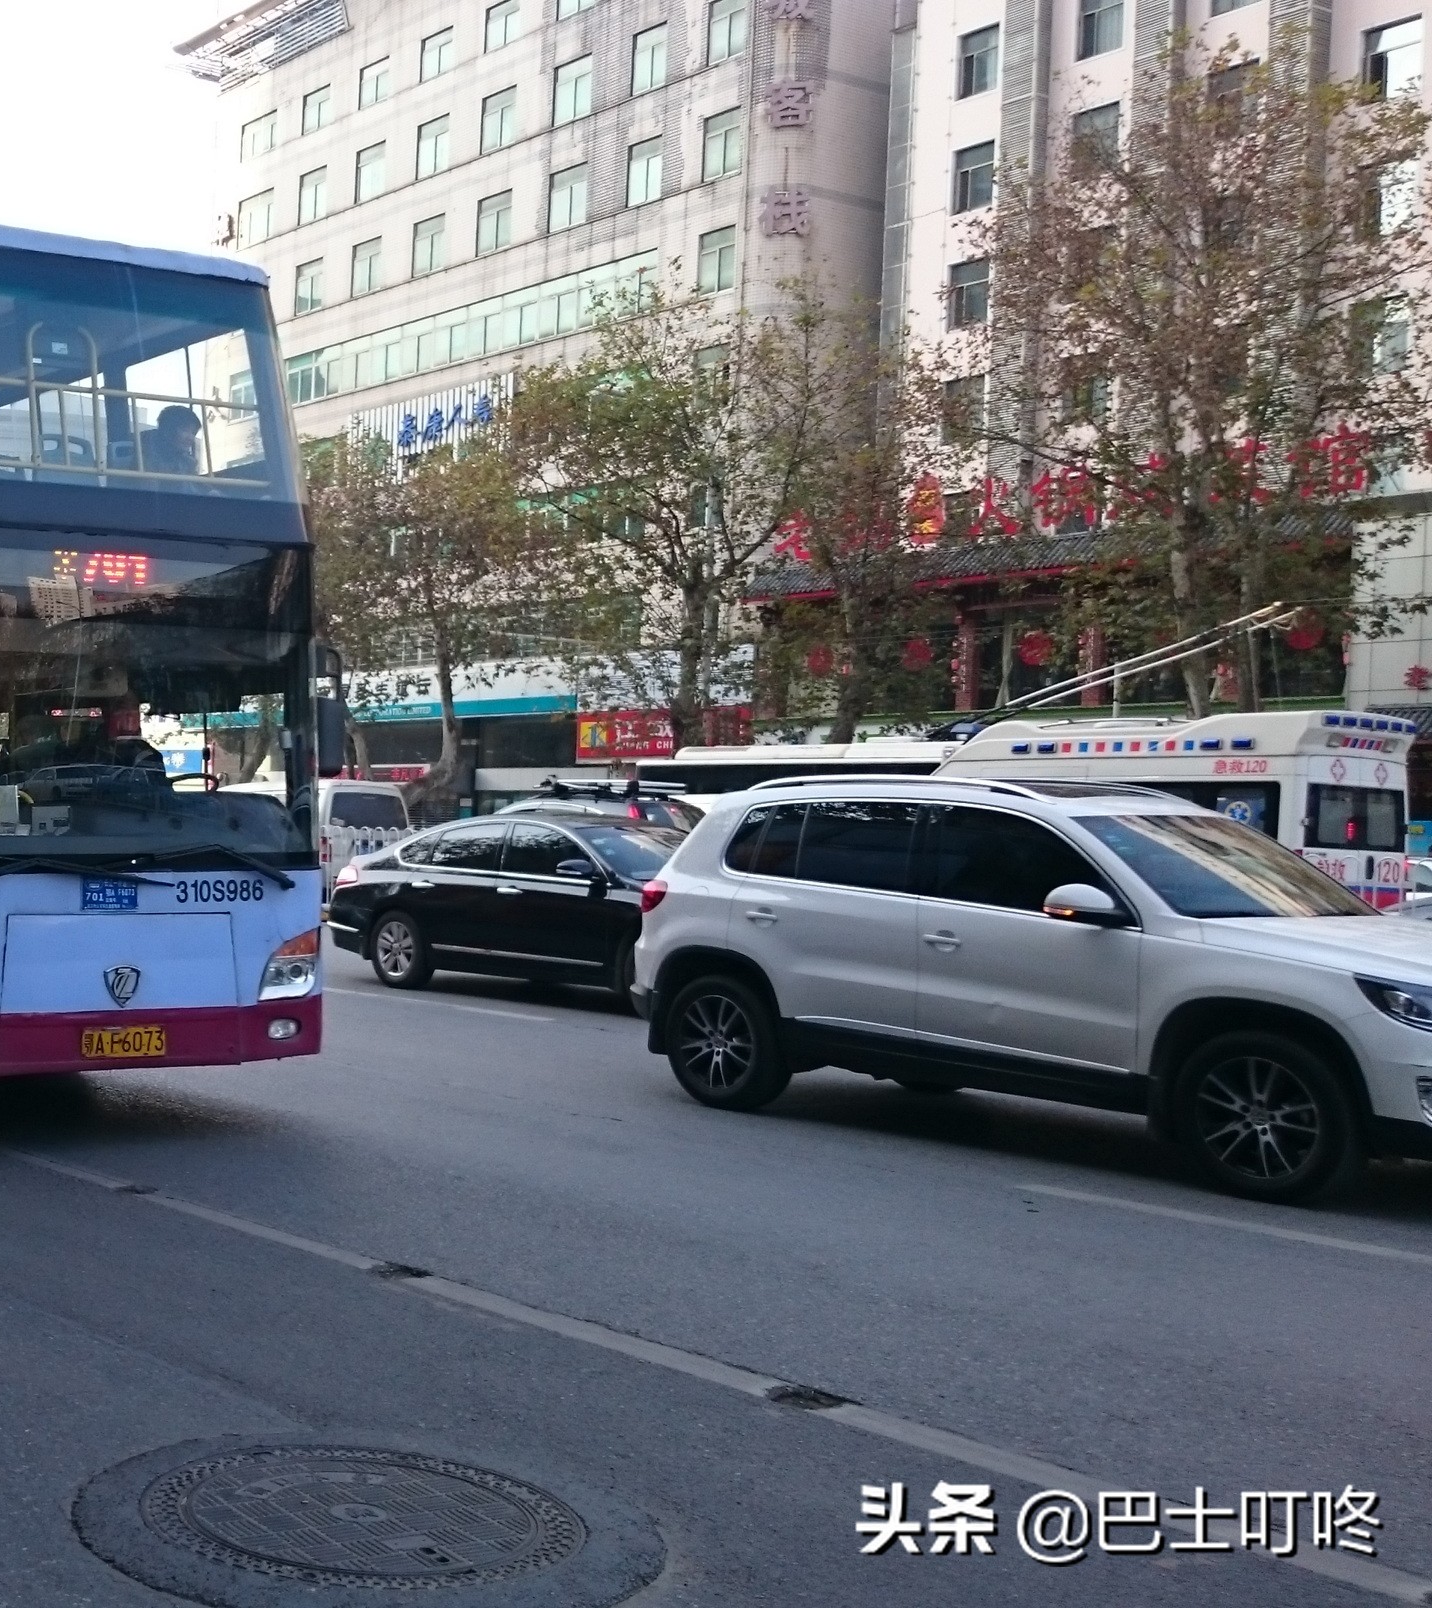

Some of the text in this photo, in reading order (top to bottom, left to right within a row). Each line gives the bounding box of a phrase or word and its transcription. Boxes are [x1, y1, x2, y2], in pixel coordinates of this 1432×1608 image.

[1212, 759, 1268, 775] 急救120
[1377, 860, 1400, 883] 120
[85, 892, 104, 902] 701
[176, 879, 264, 903] 310S986
